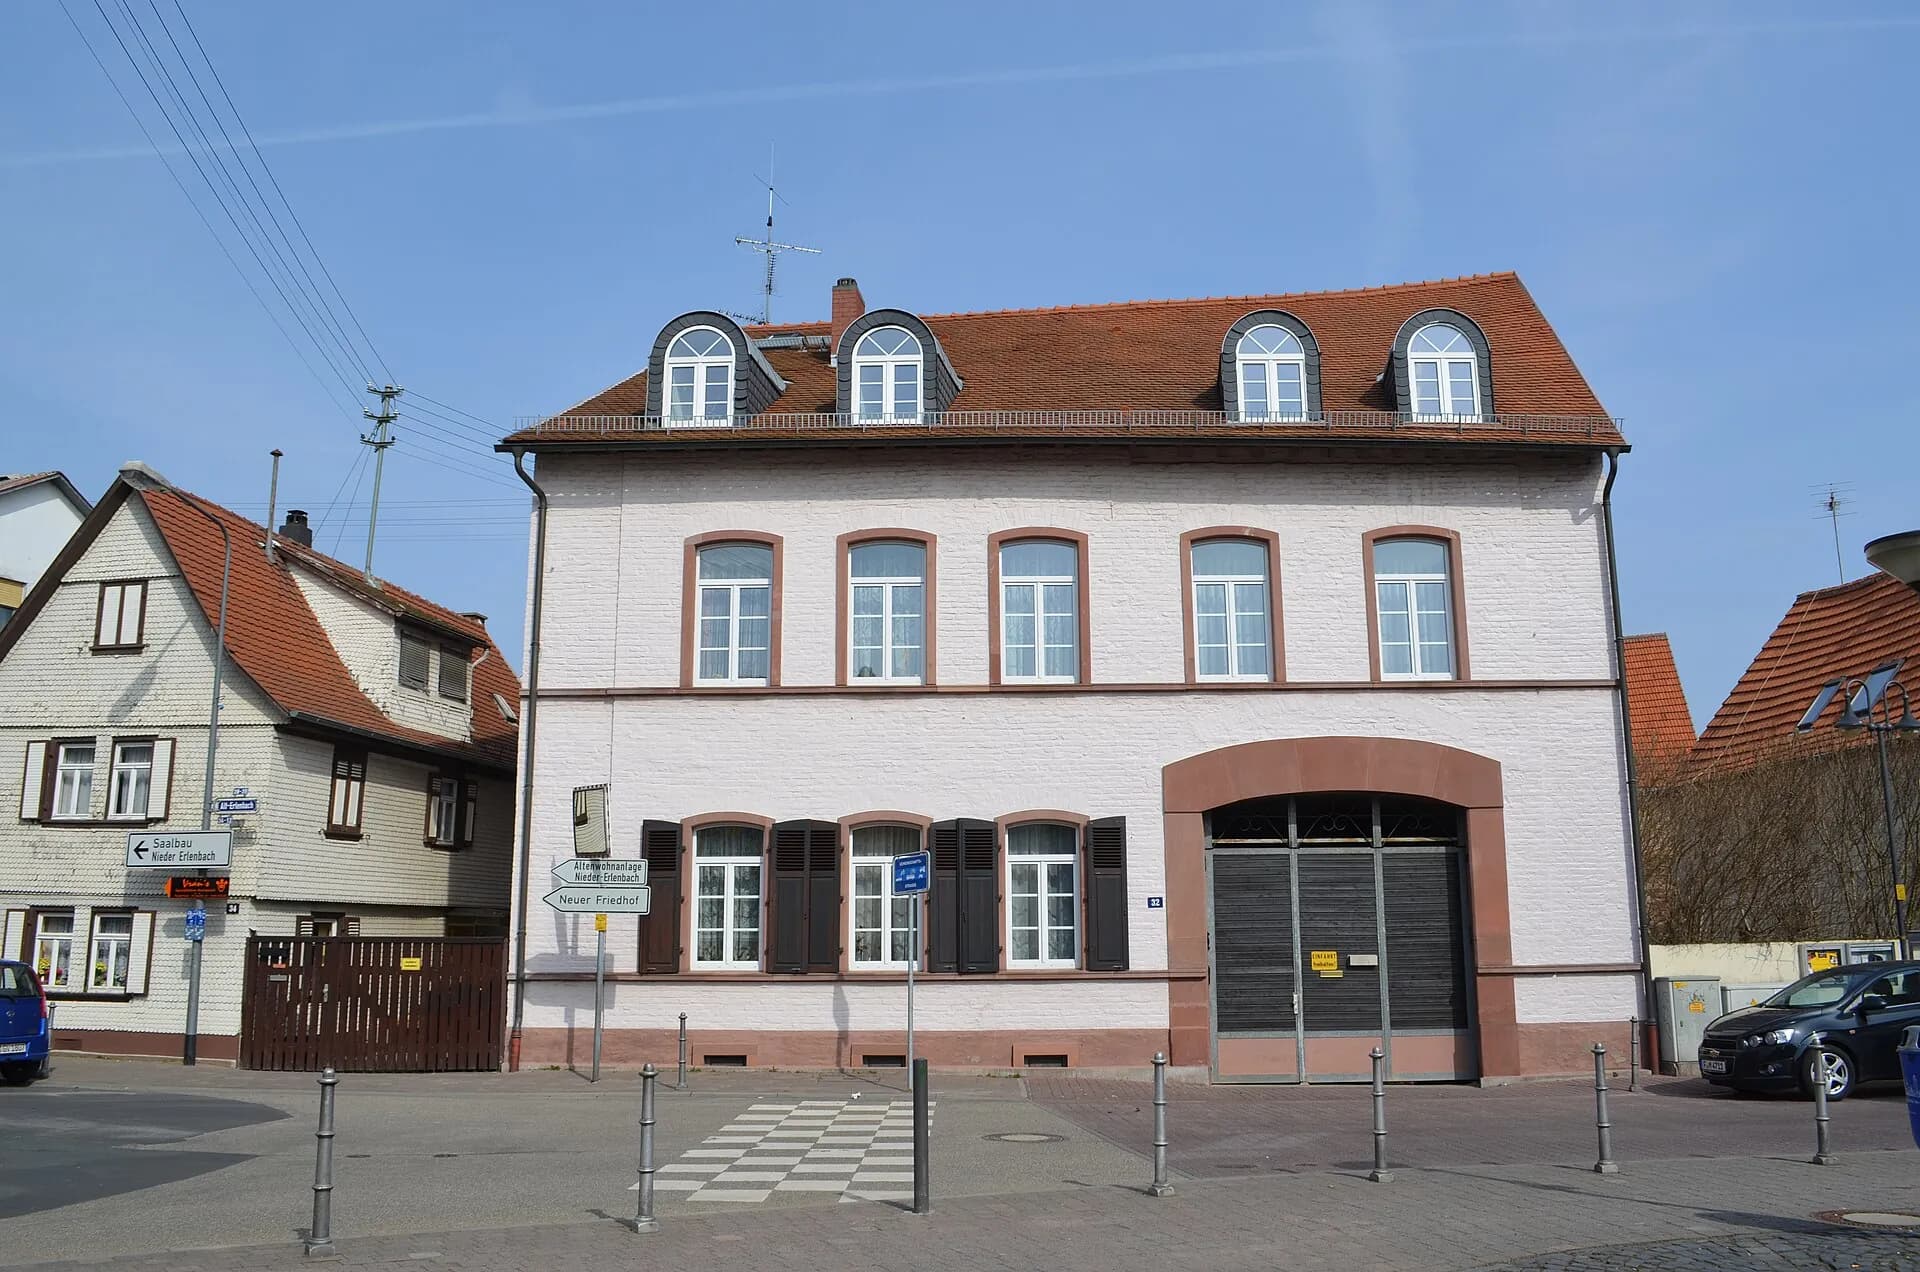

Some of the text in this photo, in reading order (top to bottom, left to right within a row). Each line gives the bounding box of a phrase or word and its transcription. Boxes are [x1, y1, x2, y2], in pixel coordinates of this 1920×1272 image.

[153, 838, 192, 848] Saalbau
[151, 850, 216, 861] Nieder Erlenbach
[574, 861, 642, 872] Altenwohnanlage
[575, 872, 640, 882] Nieder-Erlenbach
[559, 895, 639, 904] Neuer Friedhof
[1151, 898, 1160, 906] 32
